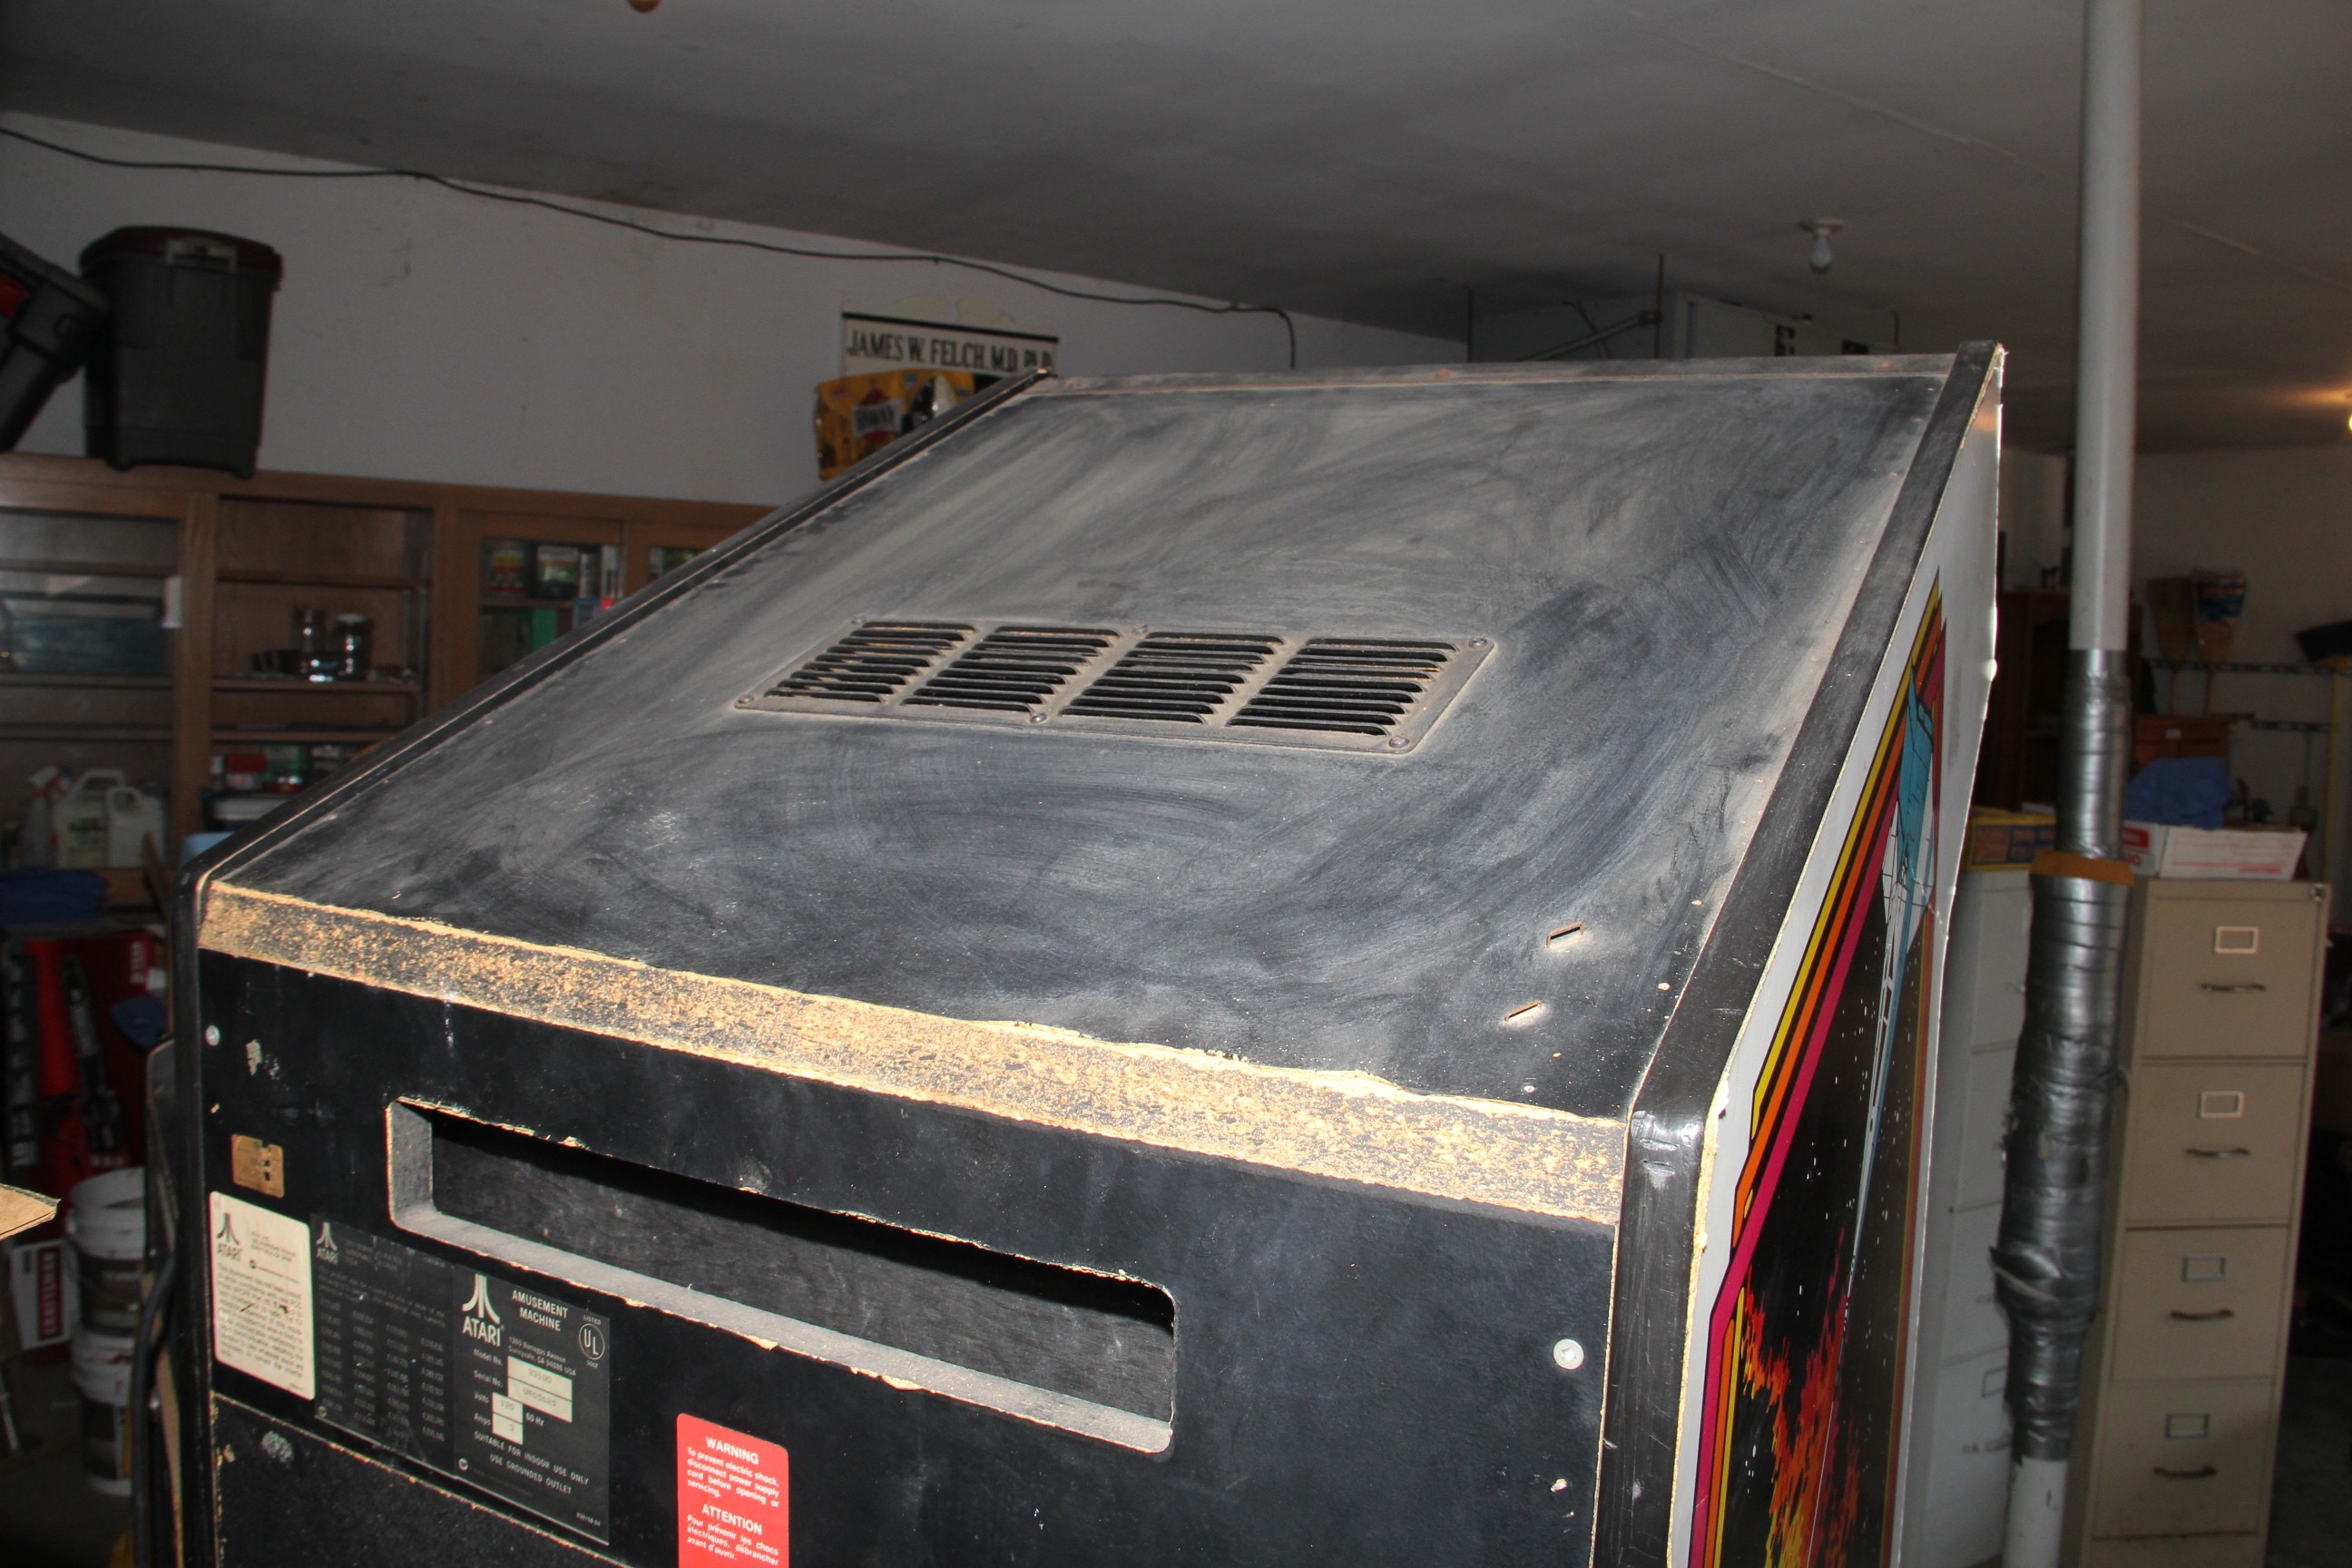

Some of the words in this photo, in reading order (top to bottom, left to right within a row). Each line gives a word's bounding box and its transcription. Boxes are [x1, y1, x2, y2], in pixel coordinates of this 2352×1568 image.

[847, 328, 903, 360] JAMES
[512, 1289, 568, 1318] AMUSEMENT
[462, 1316, 500, 1348] ATARI
[520, 1307, 561, 1331] MACHINE
[583, 1315, 602, 1326] LISTED
[474, 1348, 492, 1361] Model
[474, 1369, 492, 1382] Serial
[474, 1391, 489, 1404] Volts
[474, 1413, 491, 1426] Amps
[525, 1412, 535, 1423] 60
[474, 1431, 505, 1451] SUITABLE
[507, 1445, 522, 1456] FOR
[524, 1453, 551, 1470] INDOOR
[553, 1465, 567, 1476] USE
[570, 1472, 589, 1486] ONLY
[688, 1446, 696, 1457] To
[697, 1452, 724, 1467] prevent
[725, 1461, 752, 1477] electric
[705, 1436, 760, 1465] WARNING
[490, 1454, 504, 1465] USE
[505, 1461, 544, 1483] GROUNDED
[545, 1477, 573, 1495] OUTLET
[687, 1458, 727, 1479] disconnect
[729, 1474, 752, 1488] power
[754, 1483, 779, 1498] supply
[687, 1469, 704, 1481] cord
[708, 1475, 731, 1491] before
[736, 1486, 767, 1505] opening
[770, 1499, 779, 1507] or
[701, 1504, 762, 1535] ATTENTION
[687, 1514, 704, 1527] Pour
[707, 1523, 737, 1540] prévenir
[740, 1534, 752, 1545] les
[755, 1541, 779, 1556] chocs
[687, 1536, 711, 1552] avant
[735, 1542, 779, 1566] débrancher
